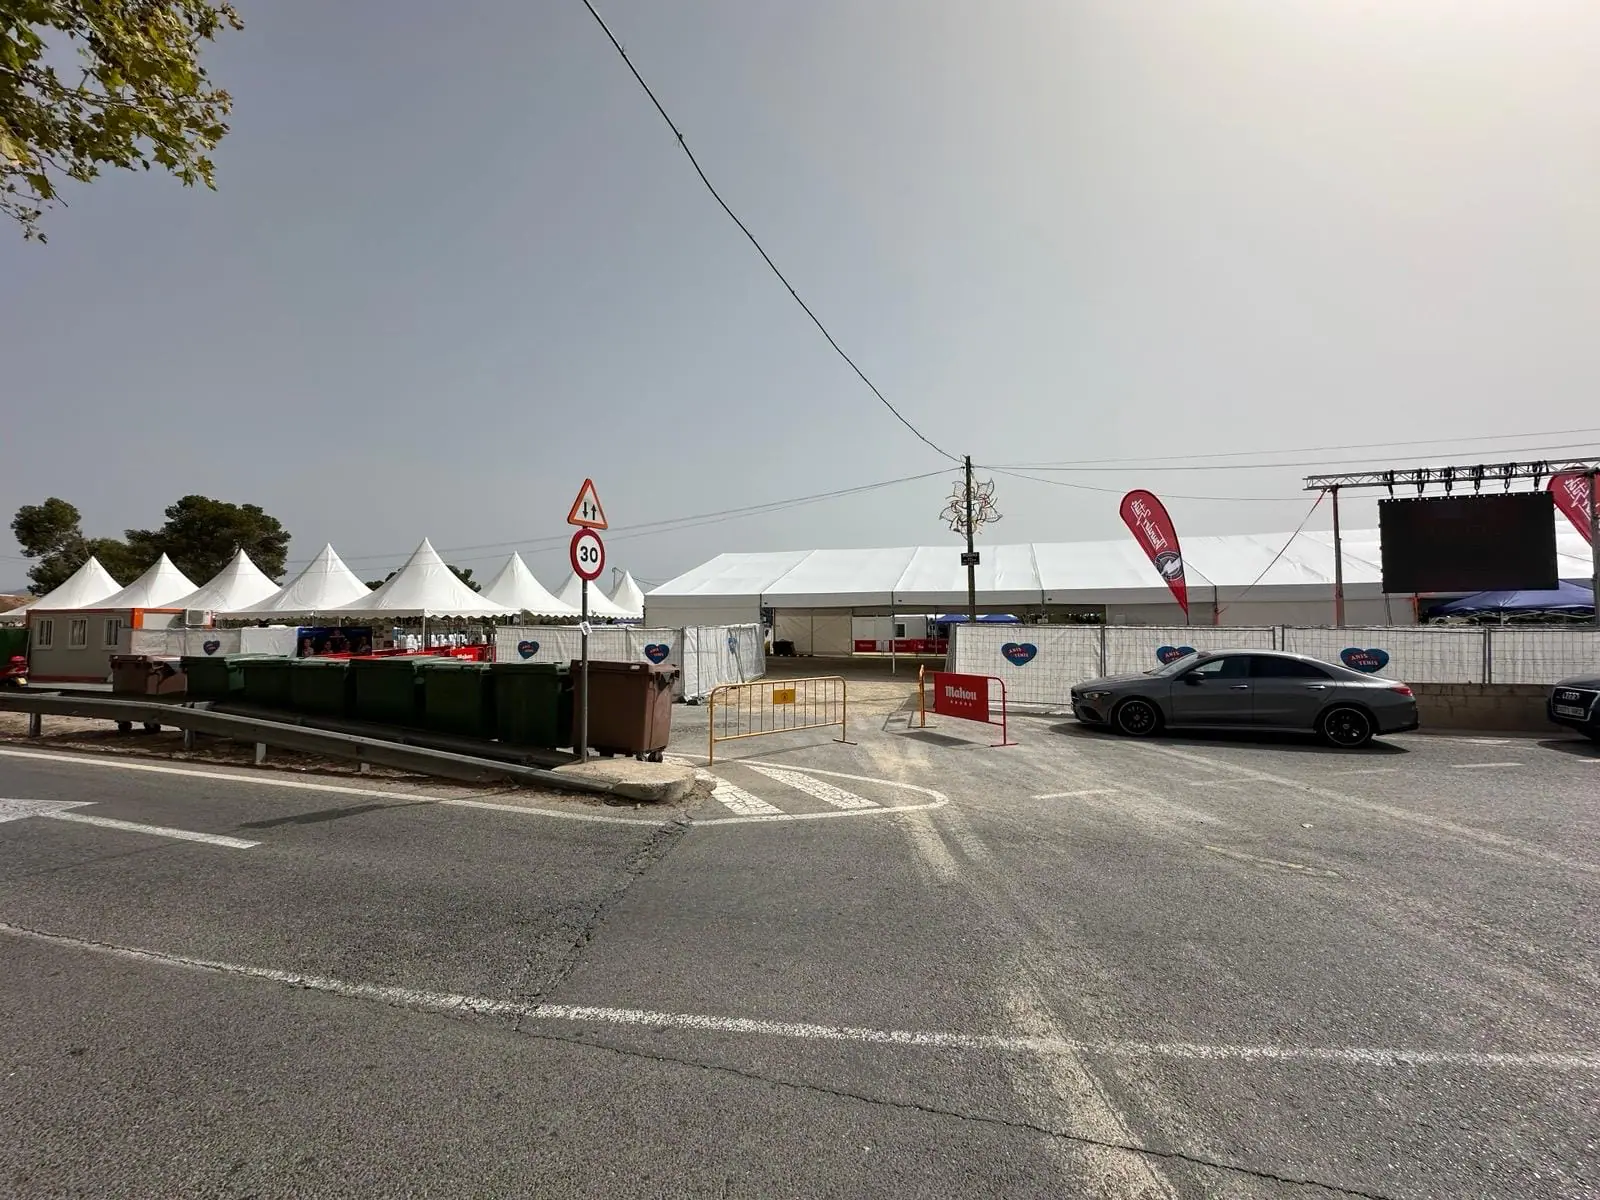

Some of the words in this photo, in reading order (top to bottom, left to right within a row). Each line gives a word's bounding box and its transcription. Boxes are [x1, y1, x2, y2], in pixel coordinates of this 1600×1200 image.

[580, 545, 598, 563] 30
[1351, 653, 1368, 661] ANIS
[945, 685, 977, 701] Mahou
